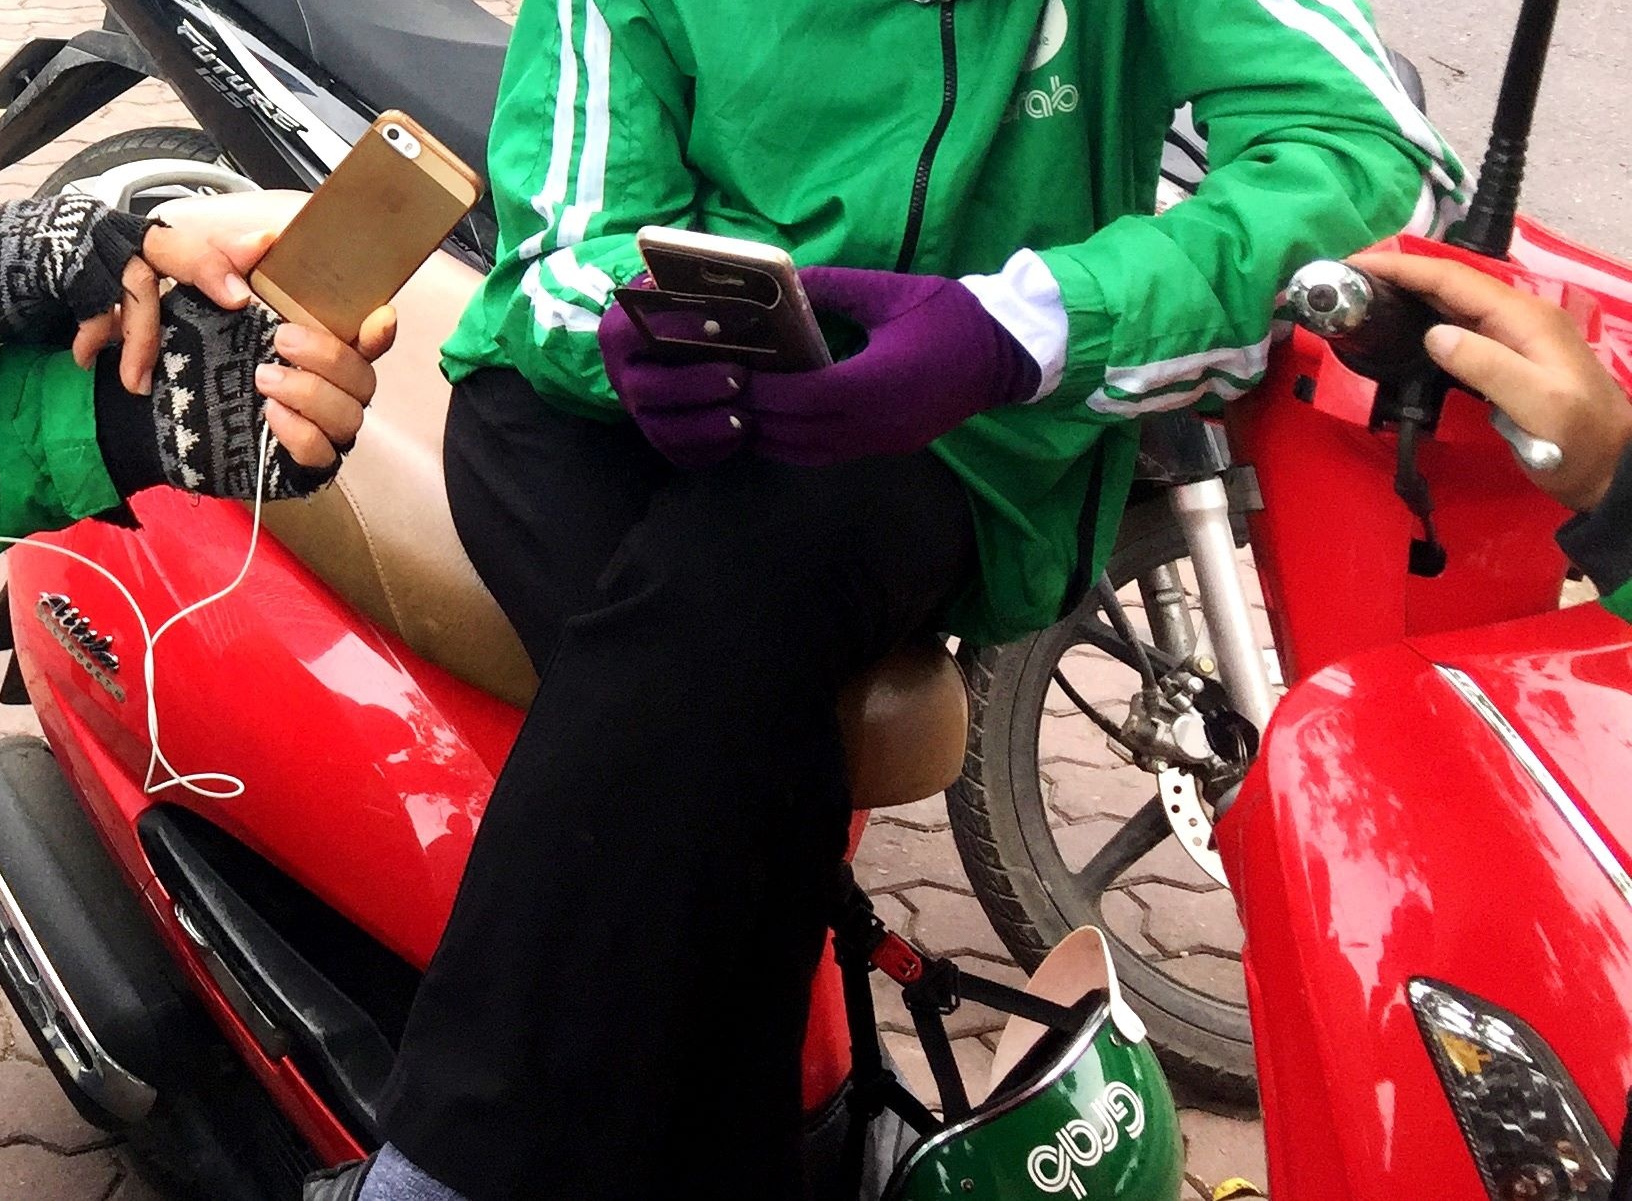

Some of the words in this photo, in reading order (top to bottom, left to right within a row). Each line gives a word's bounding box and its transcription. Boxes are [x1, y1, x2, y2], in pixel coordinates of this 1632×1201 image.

[176, 18, 303, 133] FUTURE
[194, 66, 250, 110] 125
[1027, 1080, 1146, 1201] Grab
